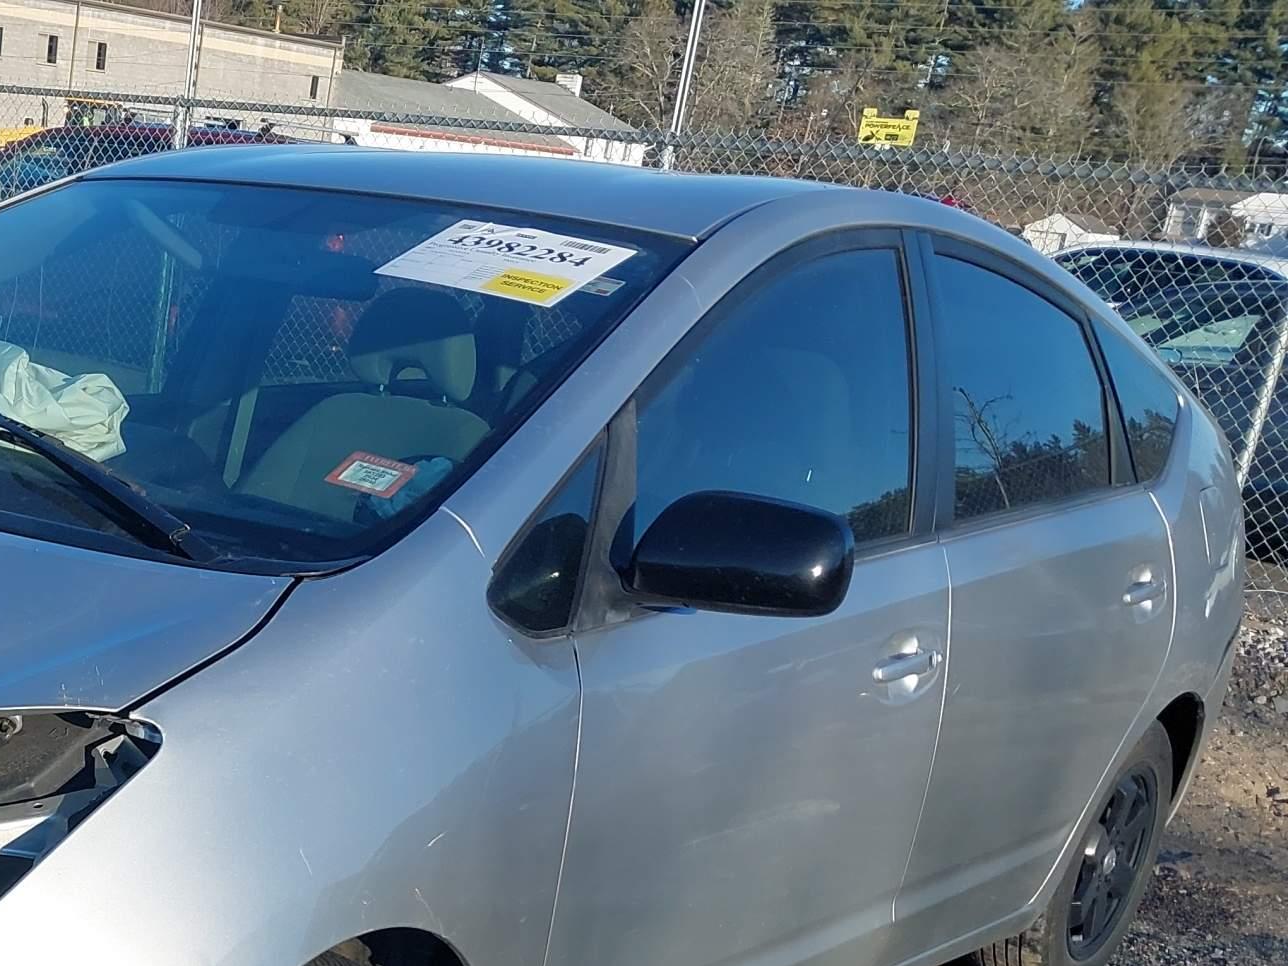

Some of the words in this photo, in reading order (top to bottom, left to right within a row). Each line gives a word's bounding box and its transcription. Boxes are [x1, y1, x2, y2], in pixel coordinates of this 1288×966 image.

[447, 235, 592, 267] 43982284
[500, 281, 546, 294] SERVICE
[501, 273, 564, 291] INSPECTION
